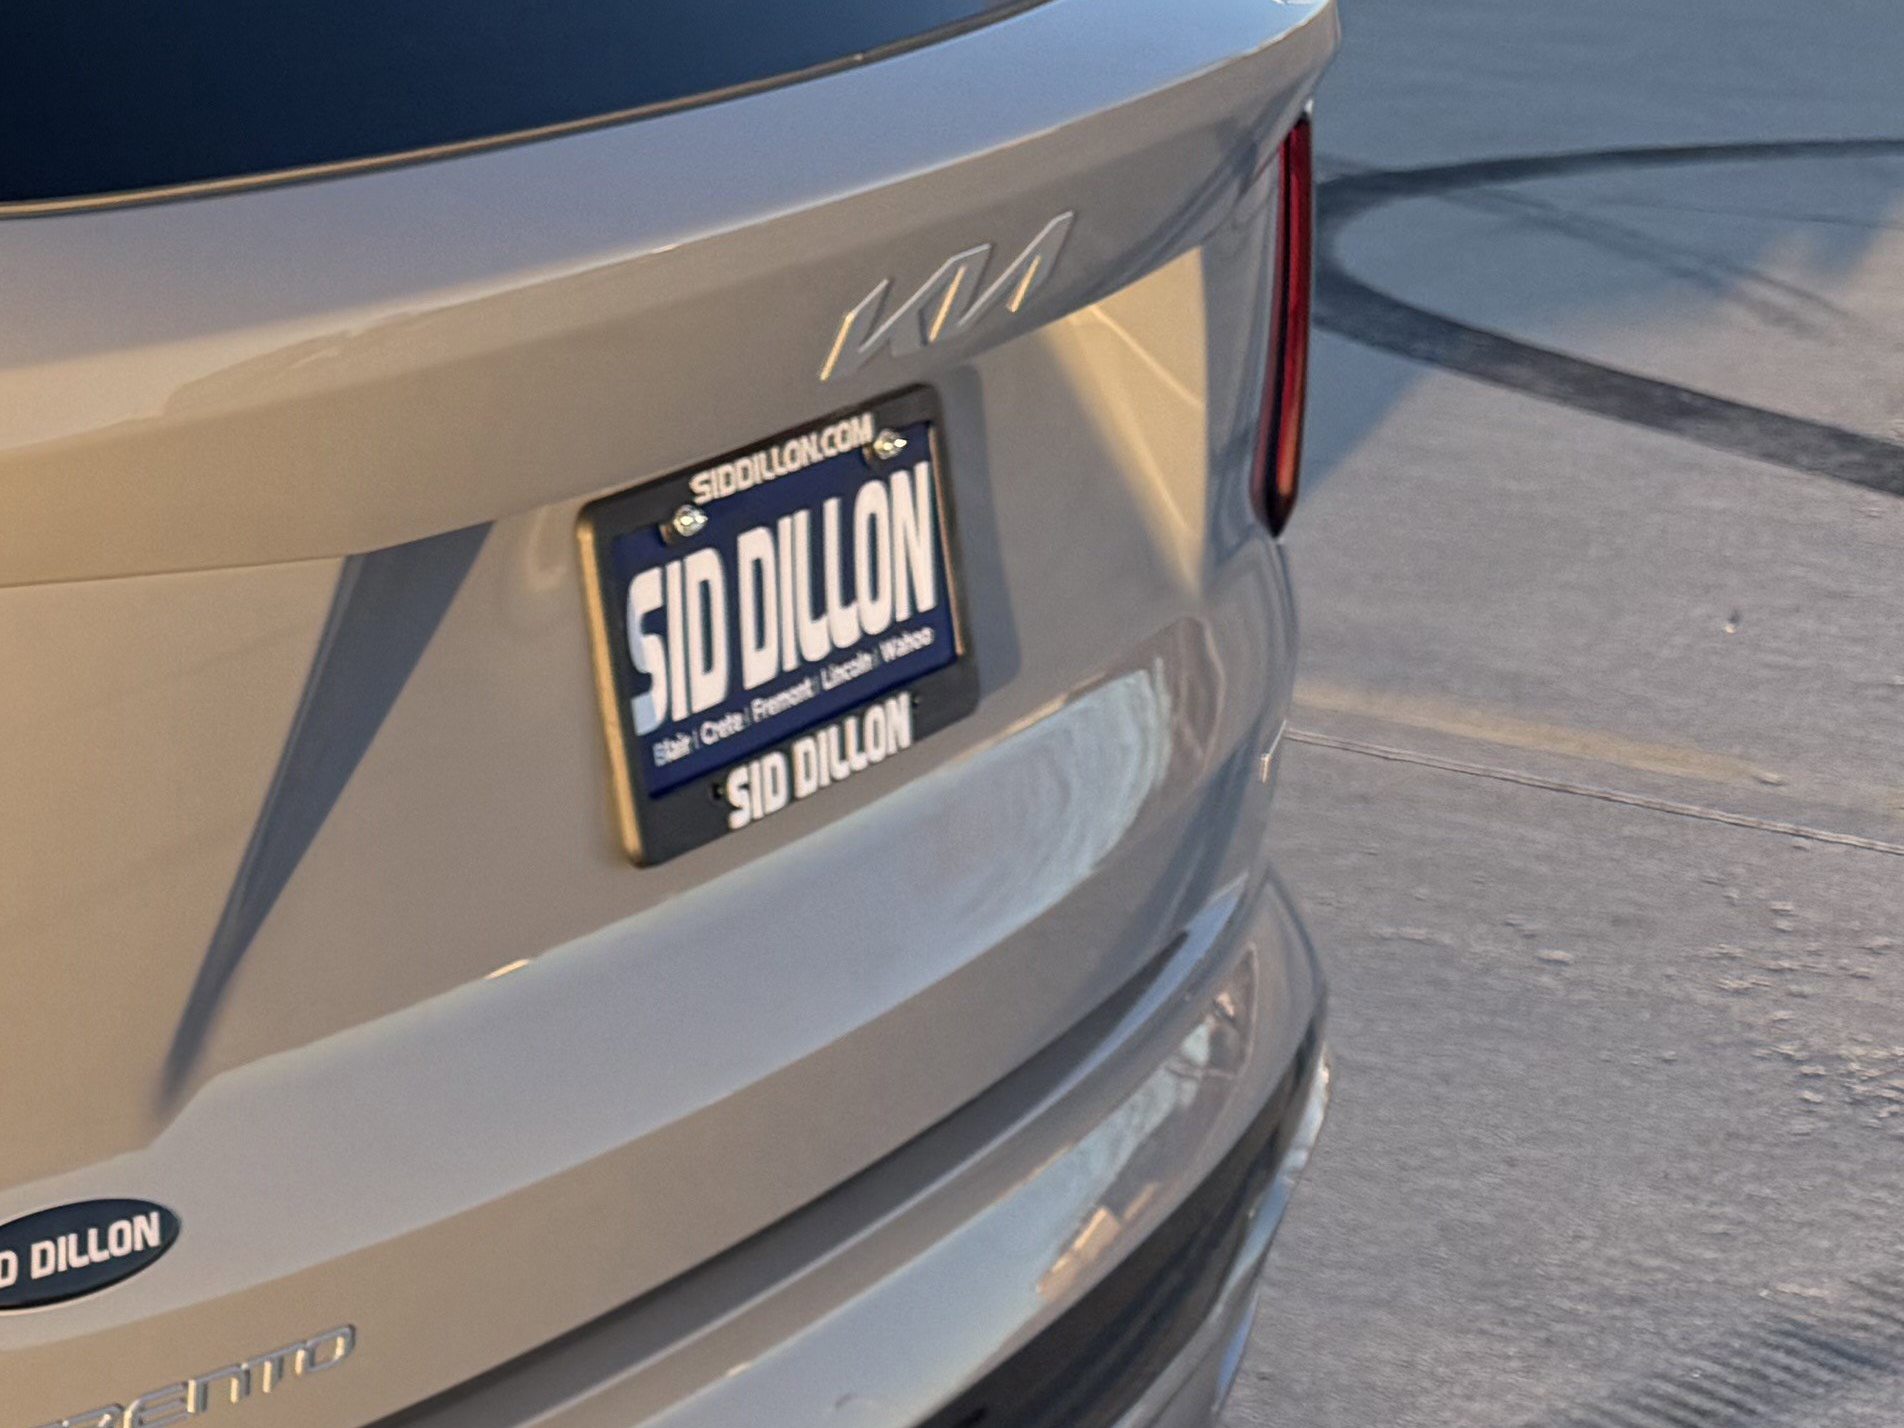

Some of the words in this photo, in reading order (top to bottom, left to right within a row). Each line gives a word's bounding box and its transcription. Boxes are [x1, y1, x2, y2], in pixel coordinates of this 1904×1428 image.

[689, 412, 875, 505] SIDDILLON.COM
[626, 547, 730, 737] SID
[737, 461, 938, 691] DILLON
[750, 676, 816, 722] Fremont
[726, 750, 789, 830] SID
[794, 691, 914, 799] DILLON
[30, 1210, 162, 1280] DILLON
